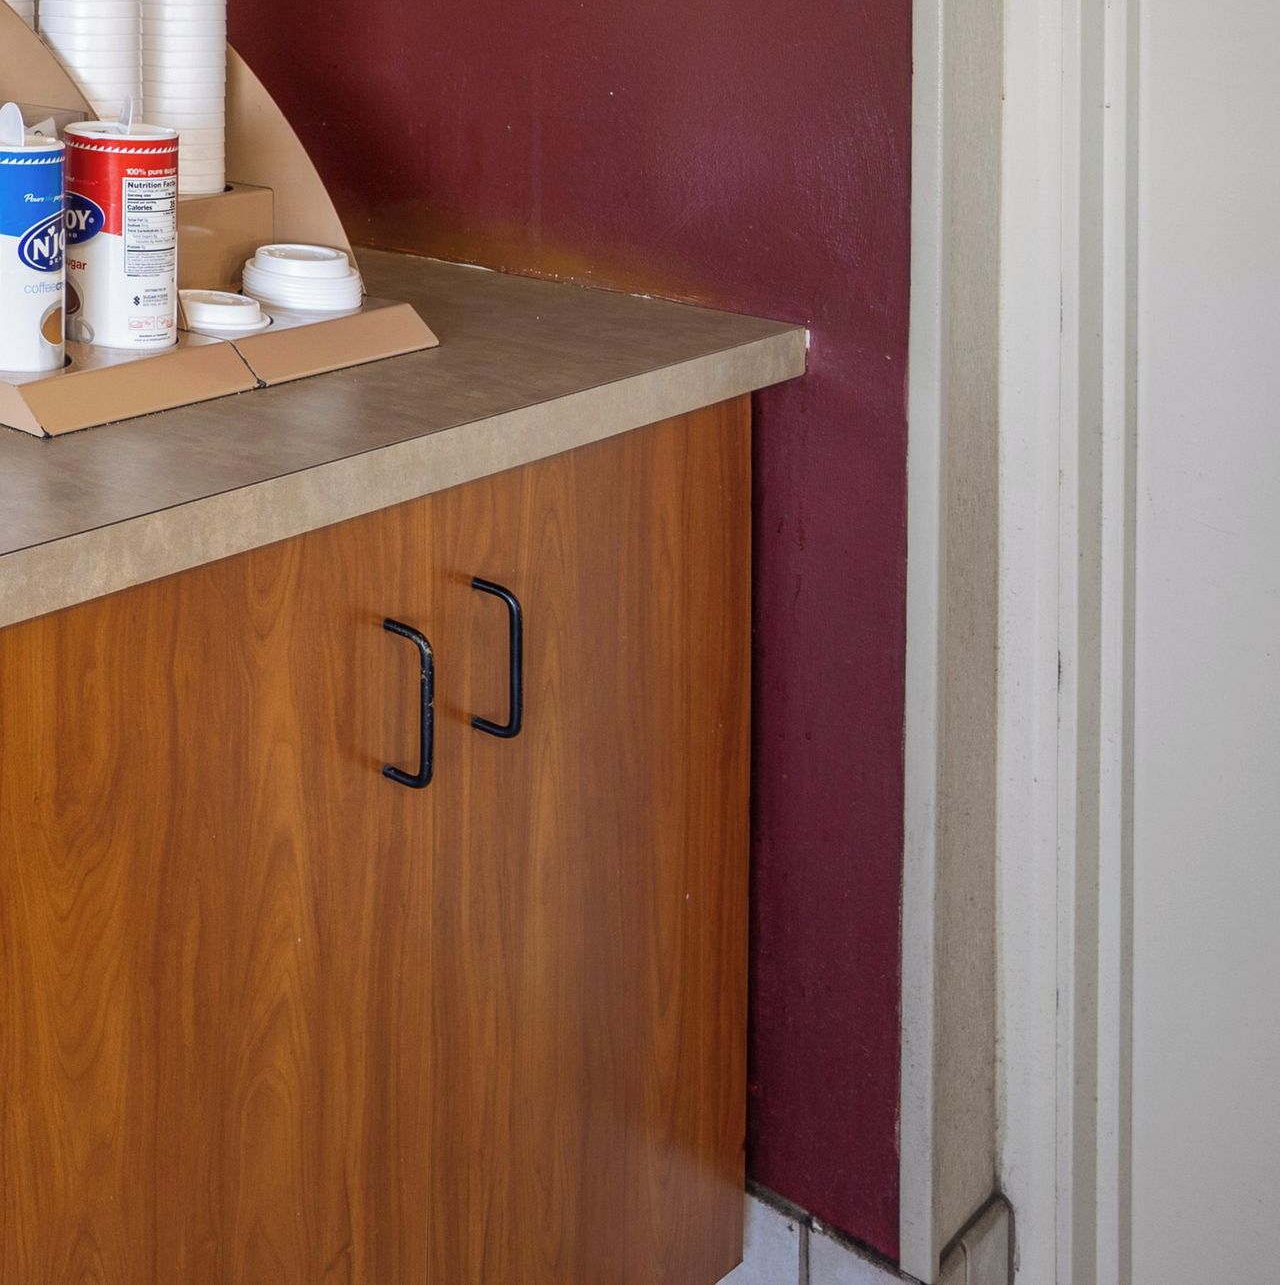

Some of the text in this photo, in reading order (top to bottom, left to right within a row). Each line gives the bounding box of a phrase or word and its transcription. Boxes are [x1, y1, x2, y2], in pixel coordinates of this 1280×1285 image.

[126, 167, 146, 175] 100%
[24, 193, 44, 203] Pours
[64, 259, 87, 271] ugar
